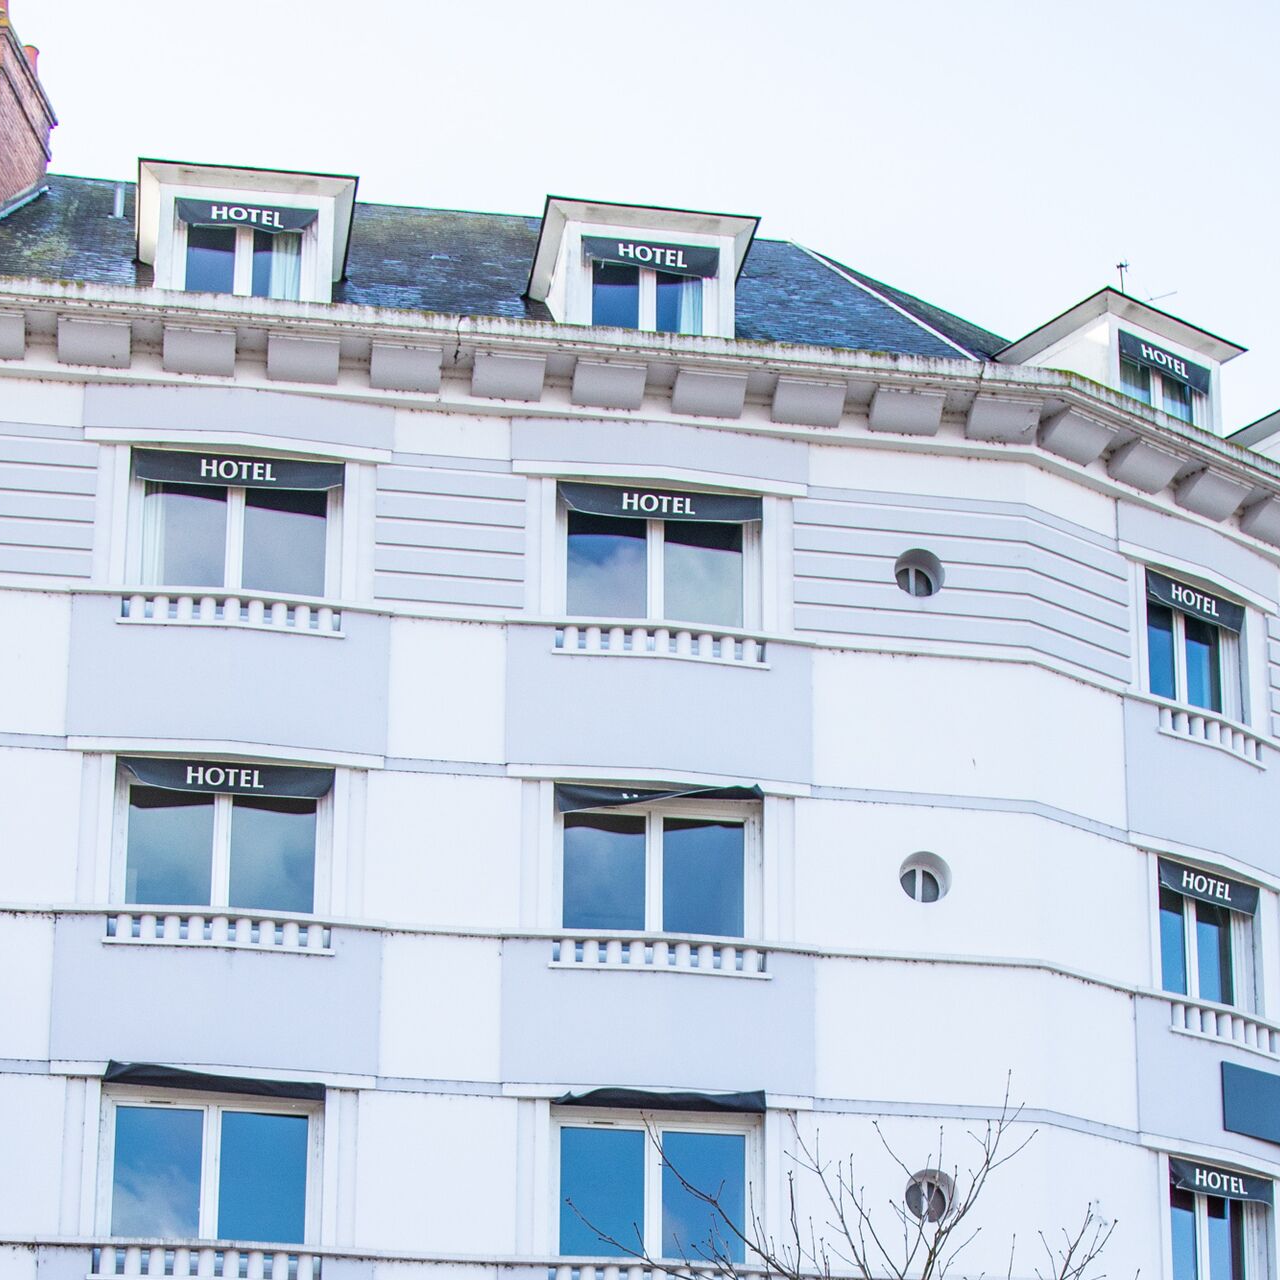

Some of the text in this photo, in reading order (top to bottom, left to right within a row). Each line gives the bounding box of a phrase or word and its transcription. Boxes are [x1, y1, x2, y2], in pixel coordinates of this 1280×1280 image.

[211, 205, 284, 229] HOTEL
[617, 242, 688, 269] HOTEL
[1140, 344, 1189, 379] HOTEL
[200, 458, 276, 482] HOTEL
[621, 491, 696, 516] HOTEL
[1170, 583, 1219, 617] HOTEL
[186, 766, 264, 789] HOTEL
[1182, 870, 1232, 902] HOTEL
[1195, 1167, 1248, 1196] HOTEL
